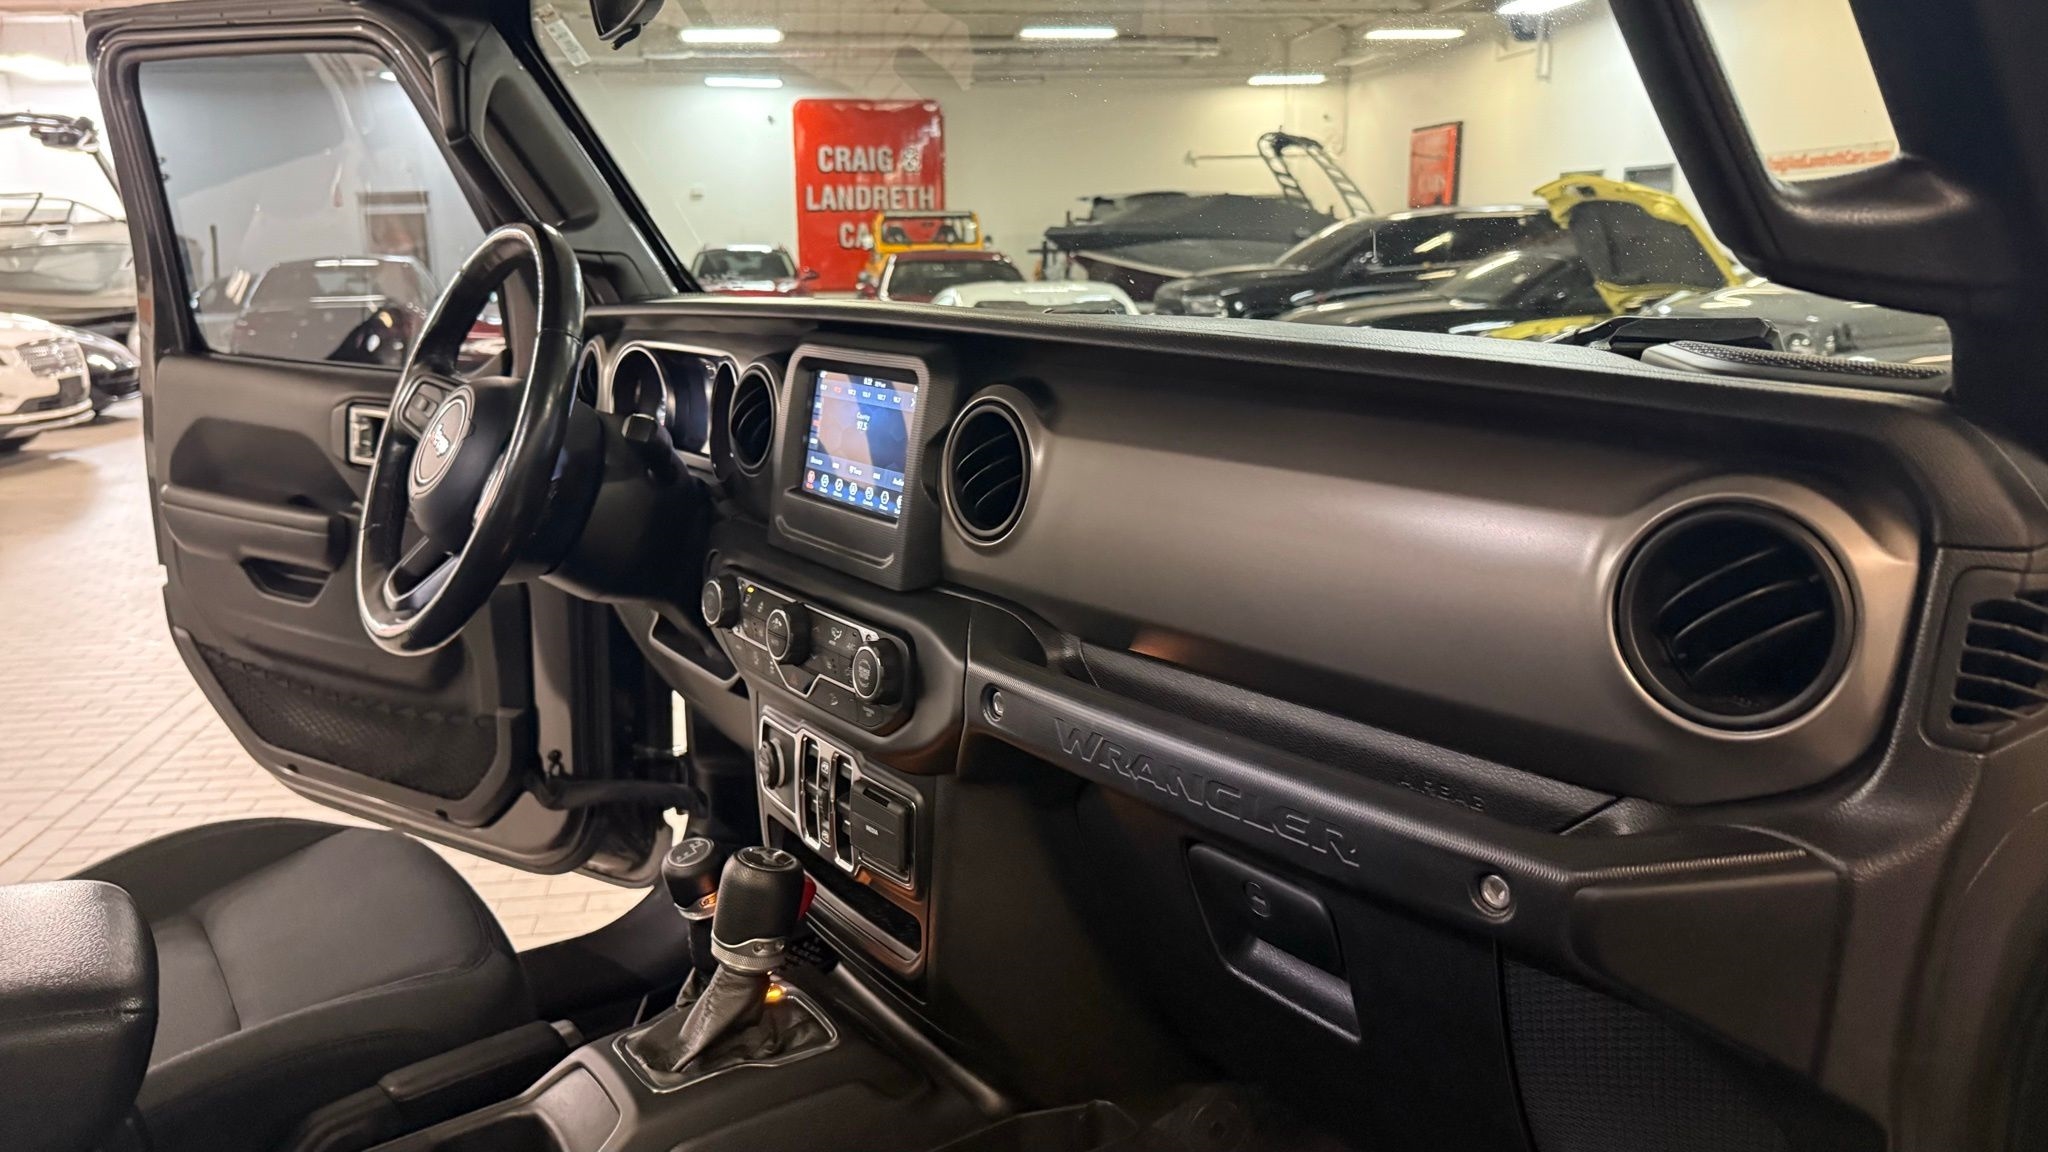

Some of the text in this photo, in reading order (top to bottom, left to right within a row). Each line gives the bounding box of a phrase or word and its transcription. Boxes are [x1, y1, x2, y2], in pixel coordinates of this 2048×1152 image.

[817, 144, 922, 173] CRAIG &
[805, 183, 935, 211] LANDRETH
[838, 222, 874, 250] CA
[1054, 717, 1359, 868] WRANGLER
